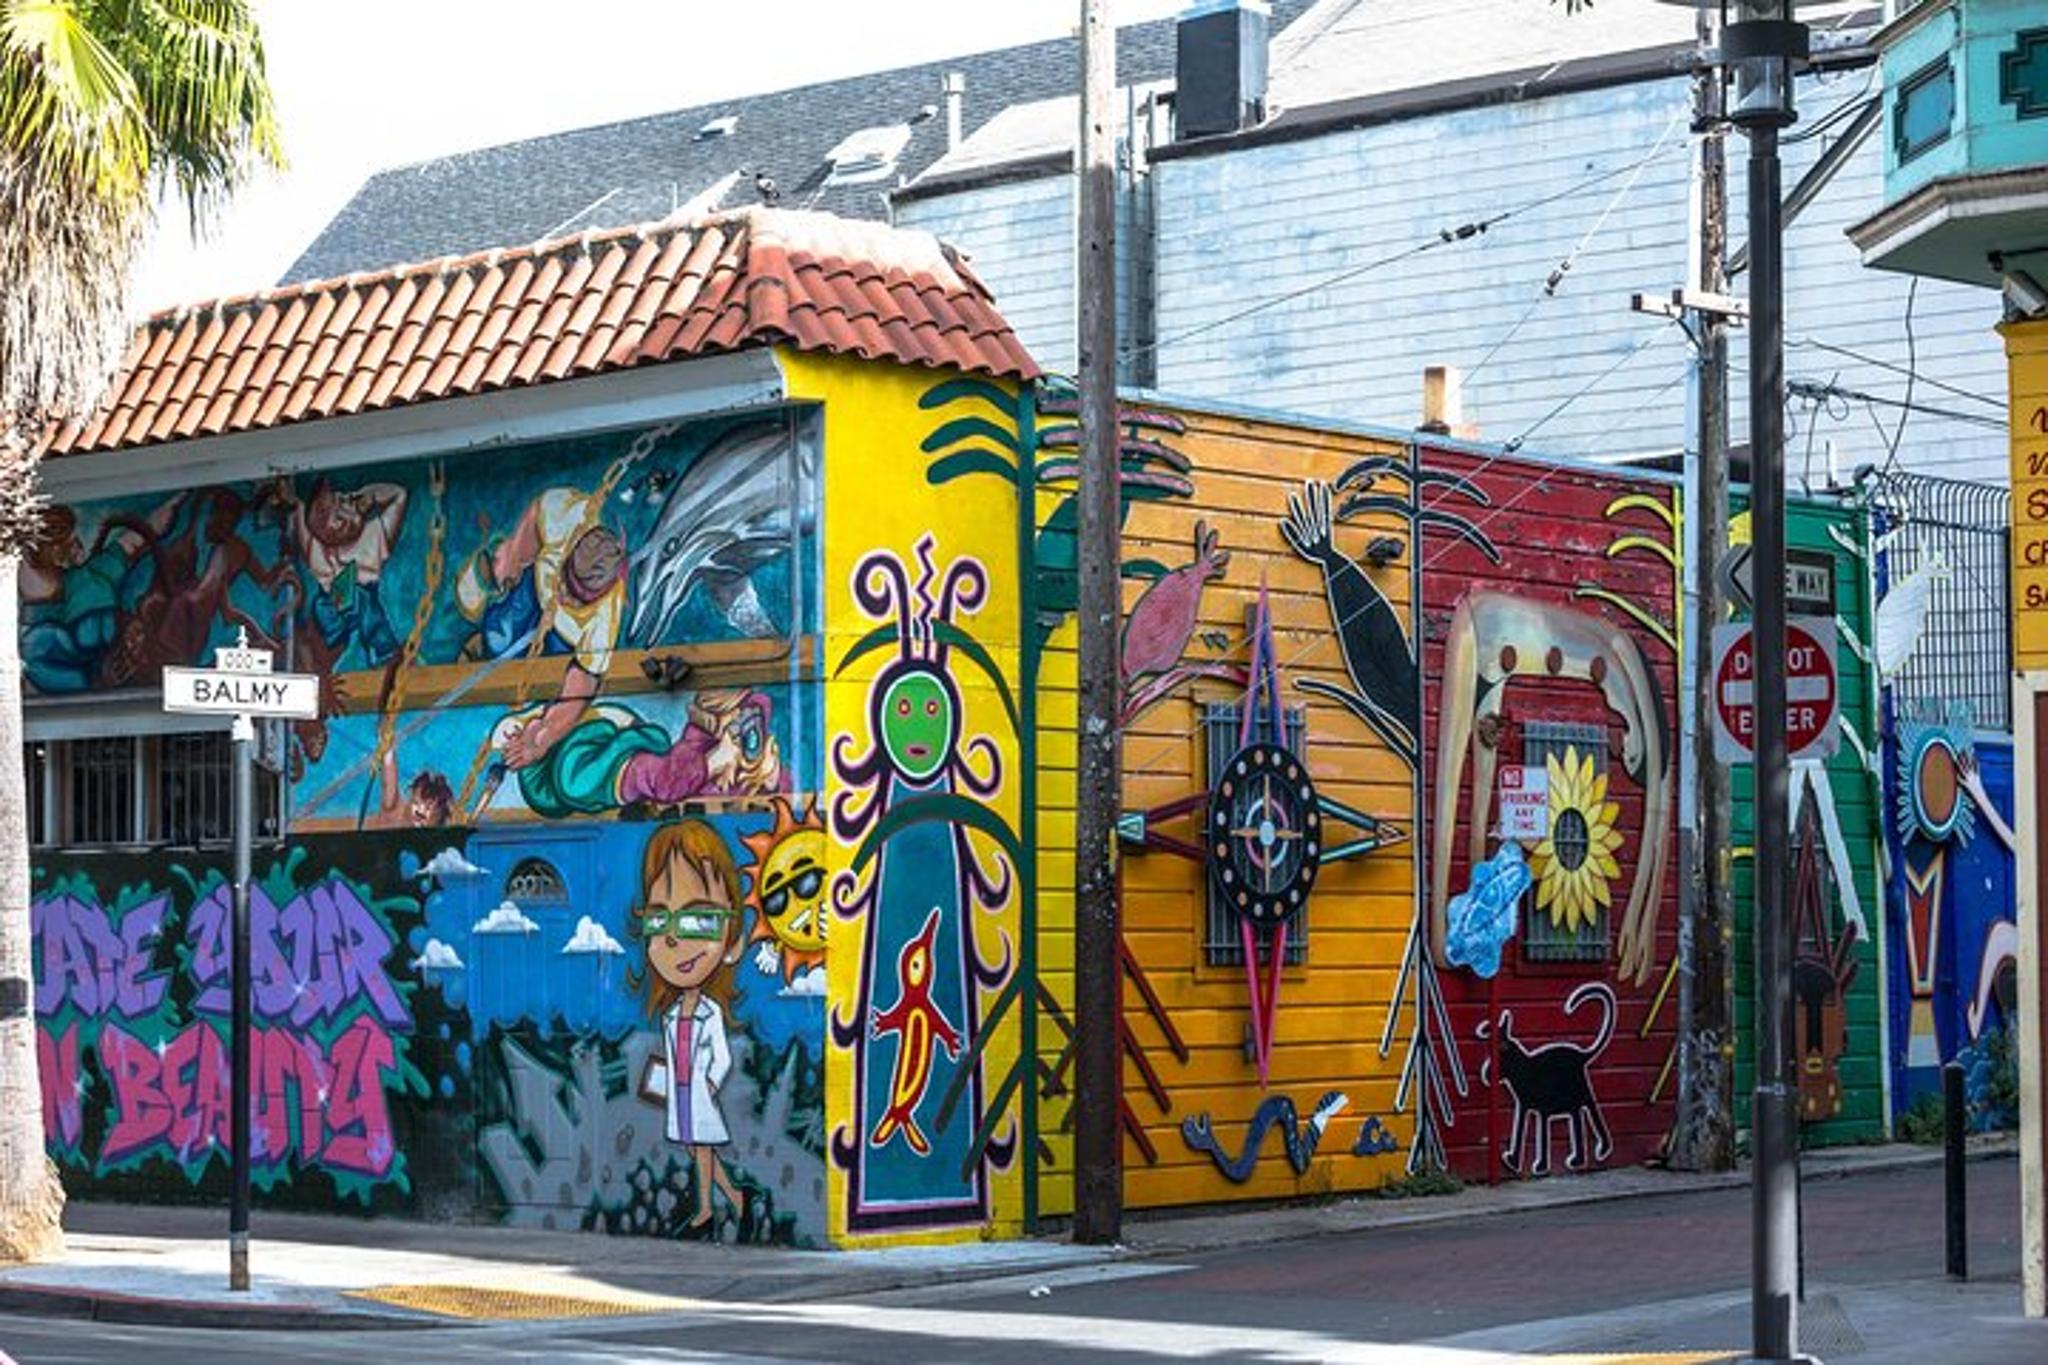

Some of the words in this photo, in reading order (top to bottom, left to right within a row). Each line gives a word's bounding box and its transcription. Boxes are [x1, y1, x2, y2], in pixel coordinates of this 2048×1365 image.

[1796, 569, 1825, 596] WAY
[1788, 647, 1816, 670] OT
[193, 679, 288, 705] BALMY
[1740, 707, 1816, 734] EER
[1515, 808, 1534, 817] ANY
[186, 878, 413, 1029] YOUR
[101, 1013, 396, 1178] BEAUTY
